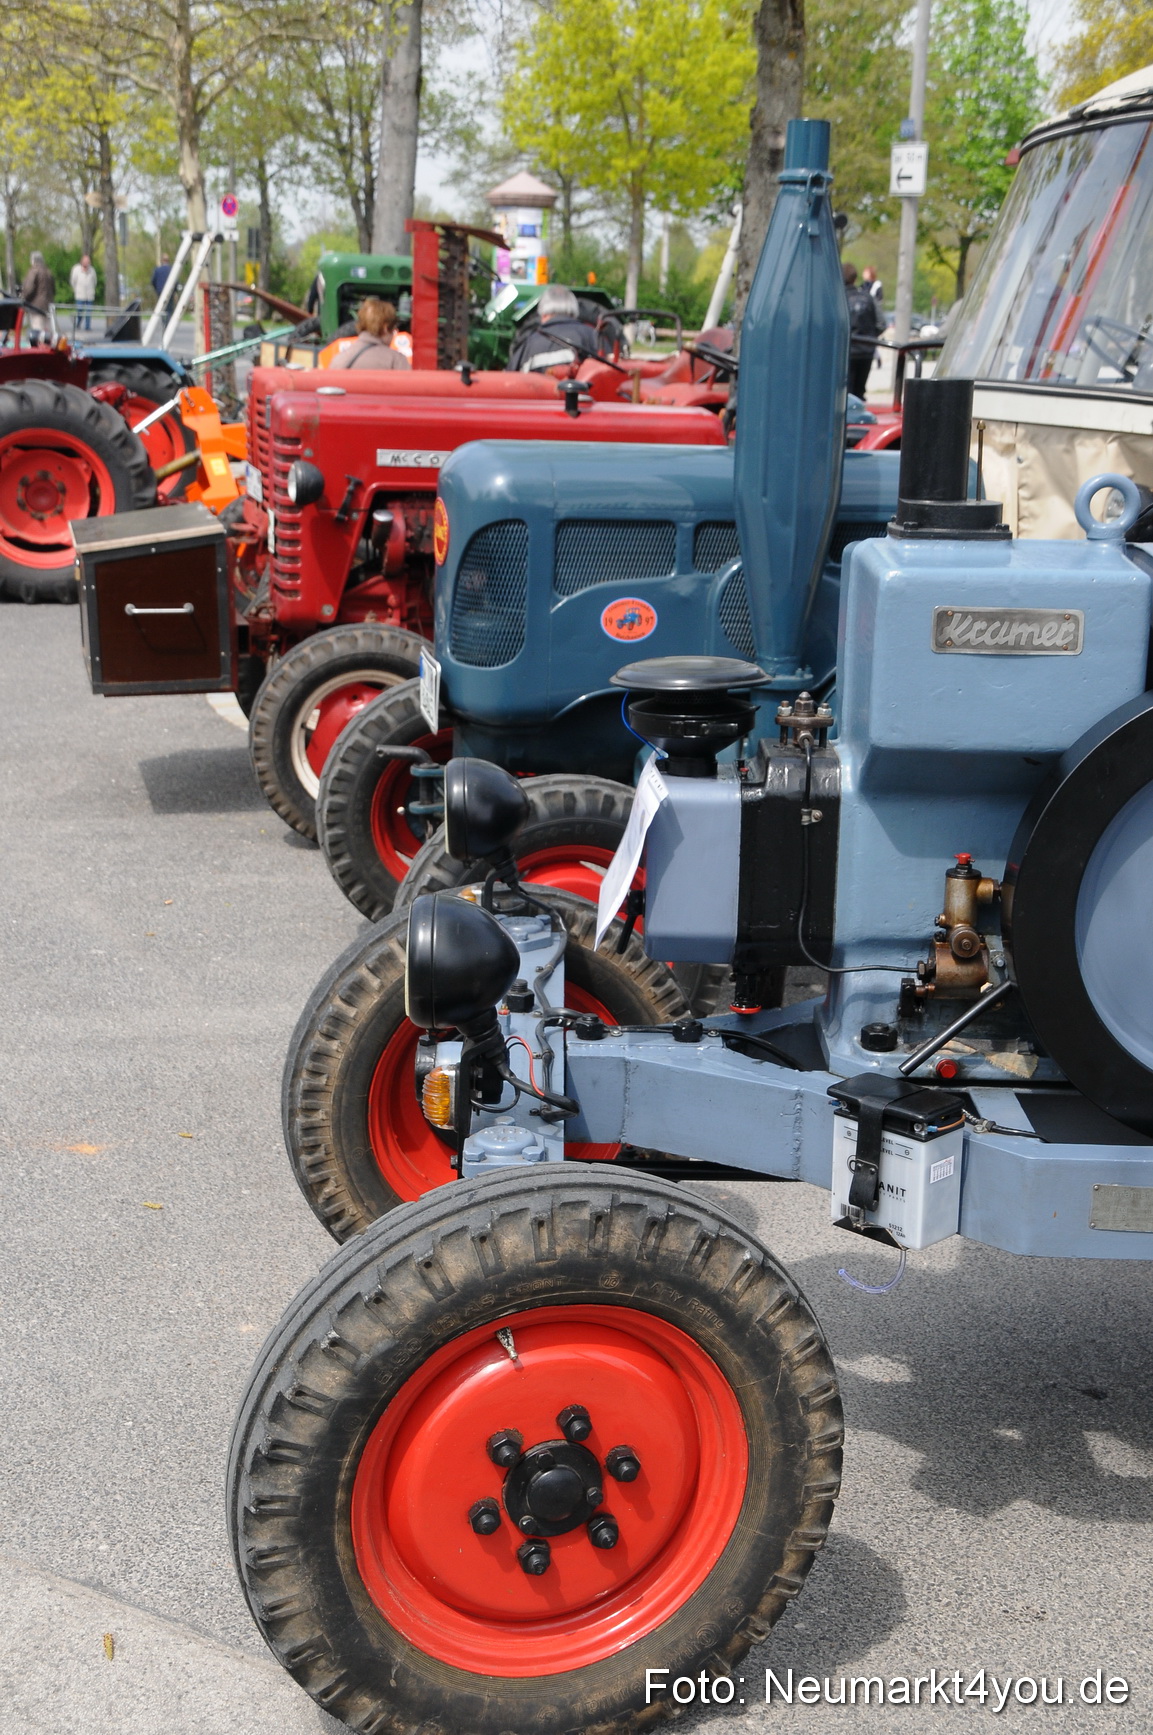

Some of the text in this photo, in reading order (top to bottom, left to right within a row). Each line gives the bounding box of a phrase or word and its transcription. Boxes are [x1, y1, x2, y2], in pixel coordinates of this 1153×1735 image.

[391, 452, 440, 466] McCO
[605, 617, 613, 626] 19
[938, 613, 1076, 647] Kramer
[879, 1181, 907, 1197] ANIT
[464, 1293, 496, 1316] AS
[505, 1275, 565, 1299] FRONT
[686, 1297, 726, 1330] Rating
